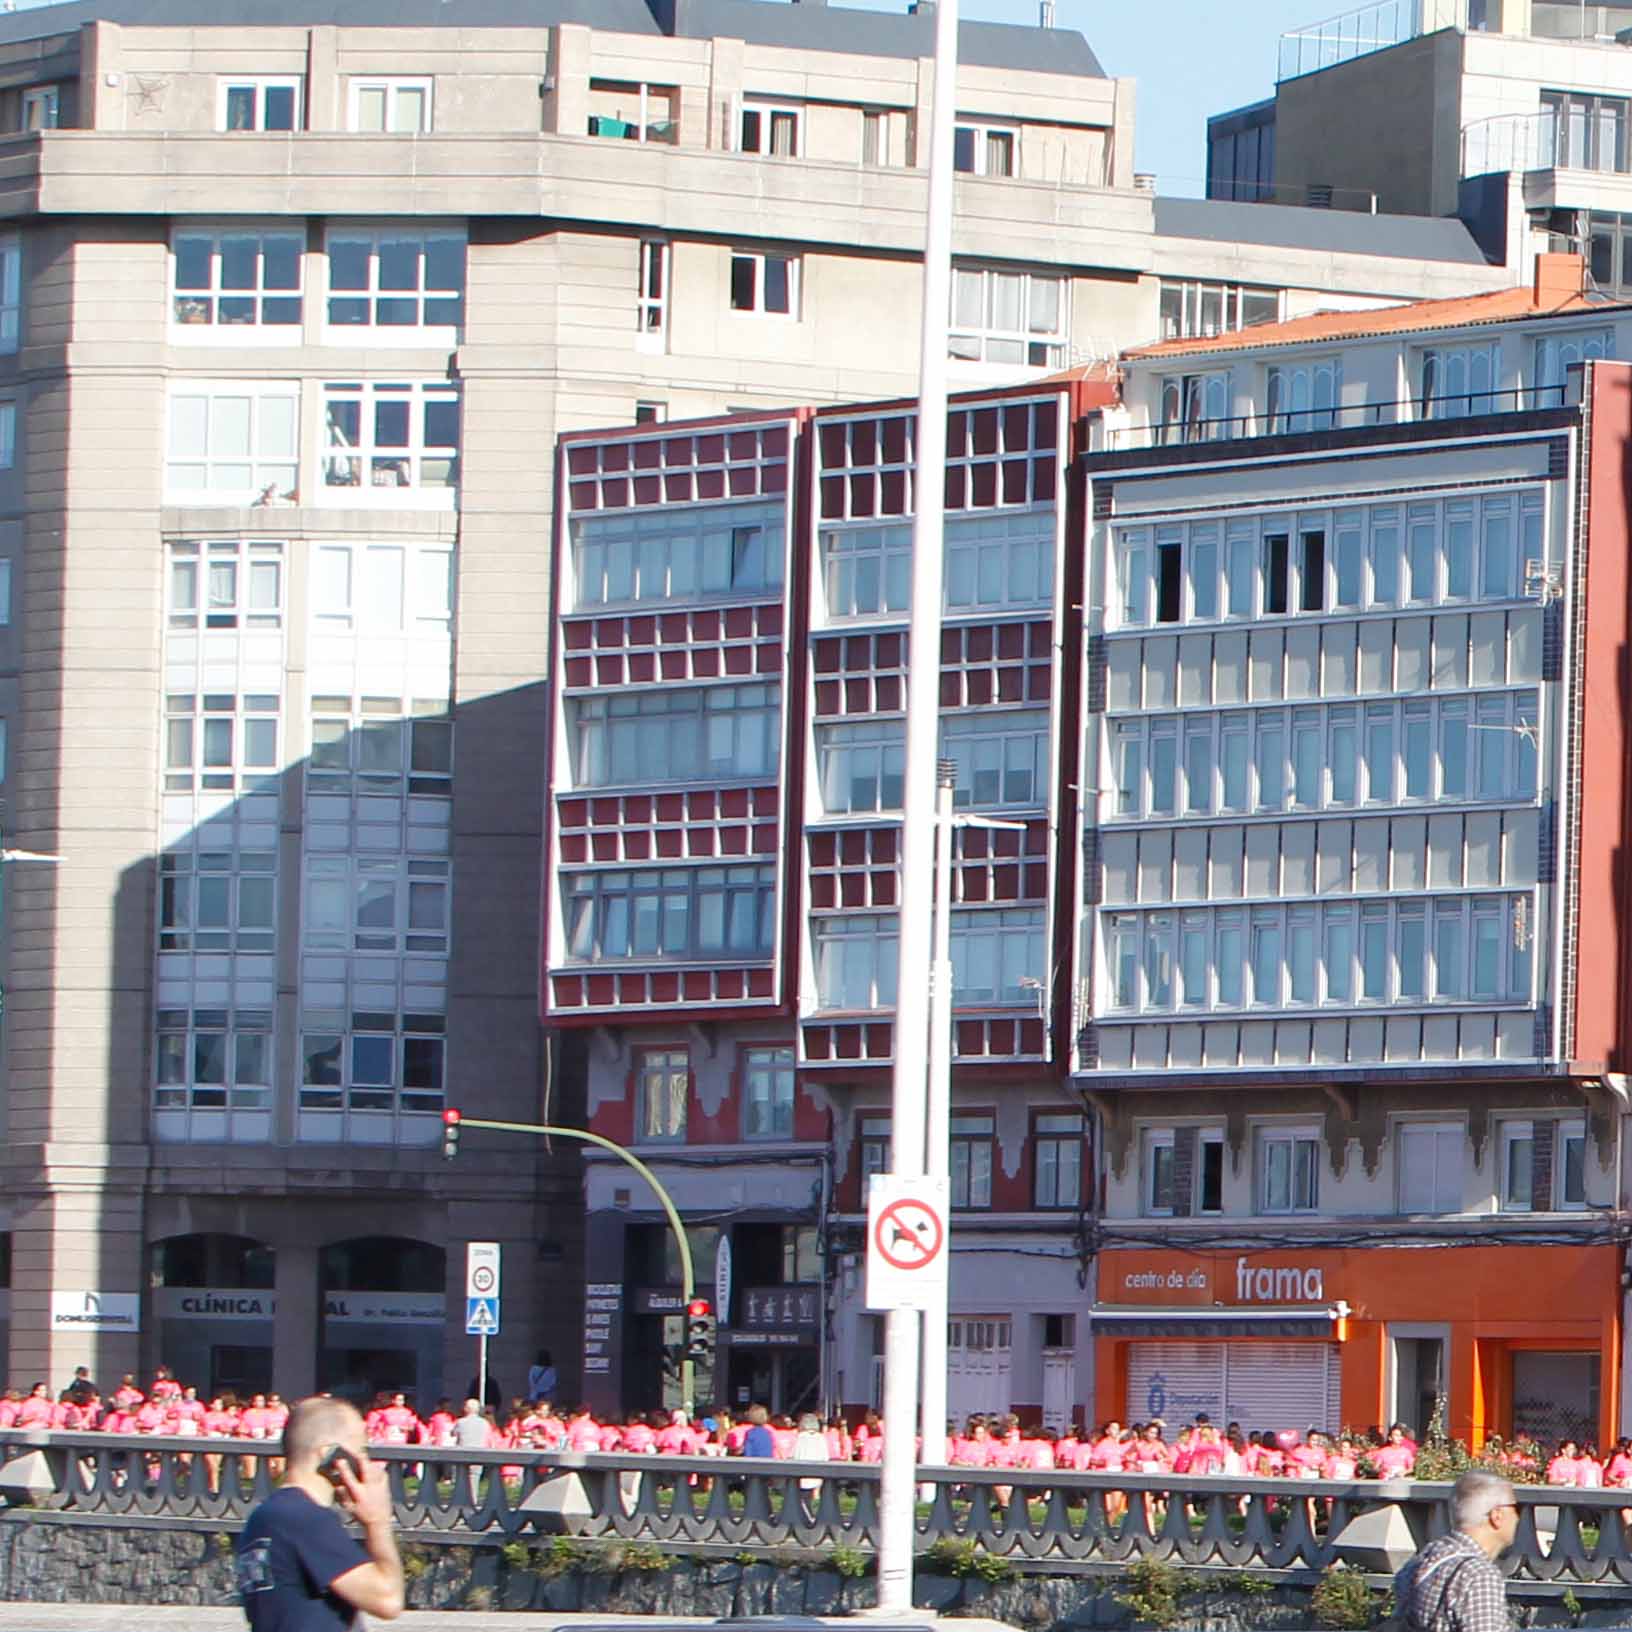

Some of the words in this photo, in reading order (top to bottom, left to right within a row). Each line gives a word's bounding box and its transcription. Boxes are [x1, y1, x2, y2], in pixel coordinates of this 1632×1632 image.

[477, 1273, 490, 1284] 30
[1125, 1269, 1165, 1288] centro
[1167, 1270, 1184, 1288] de
[1236, 1257, 1323, 1299] frama
[182, 1293, 262, 1314] CLÍNICA
